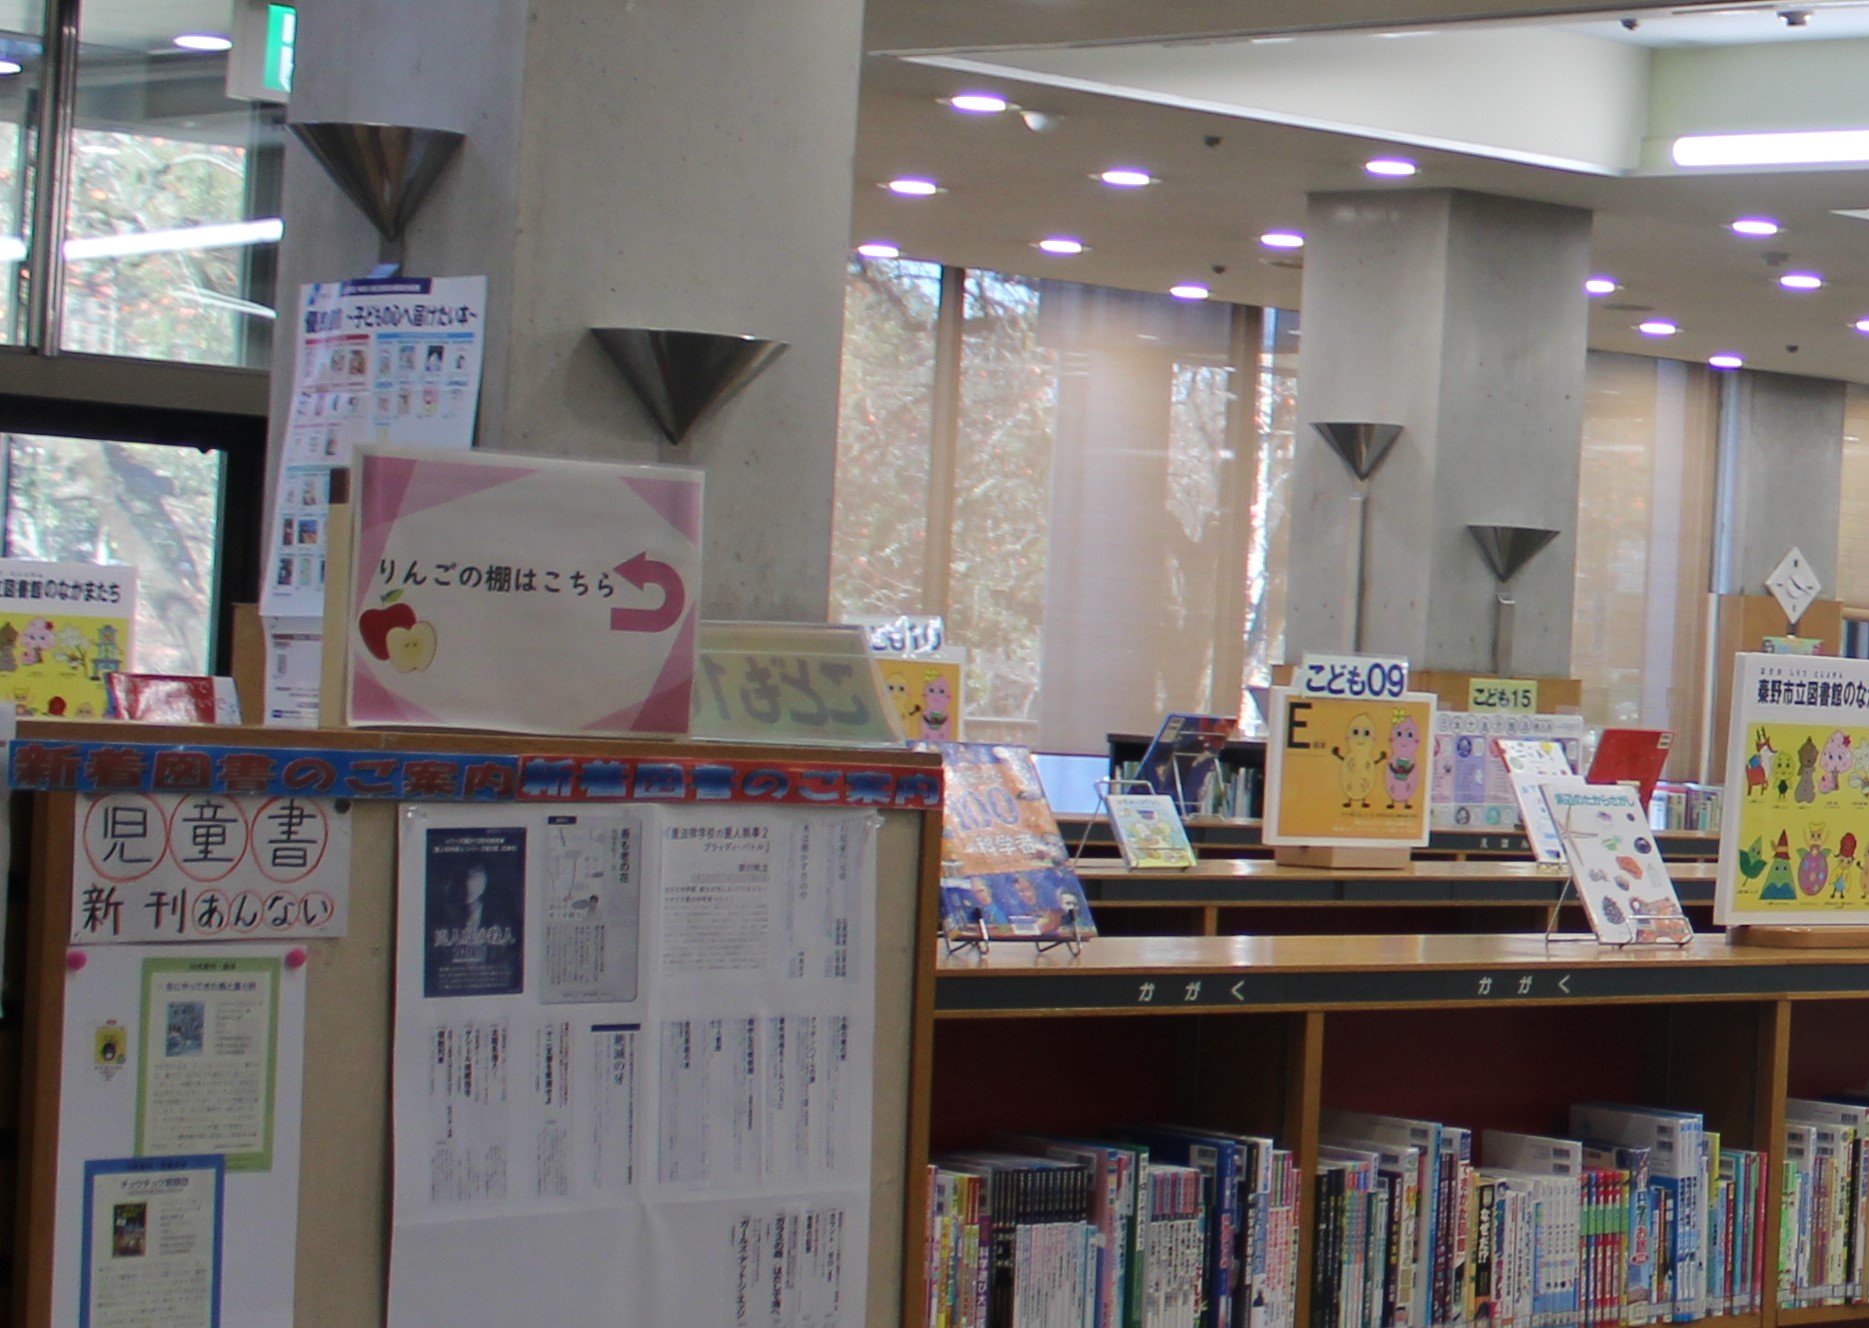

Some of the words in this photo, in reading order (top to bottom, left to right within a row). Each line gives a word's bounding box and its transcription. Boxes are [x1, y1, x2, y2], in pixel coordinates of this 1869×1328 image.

[0, 578, 122, 605] 図書館のなかまたち
[379, 558, 615, 598] りんごの棚はこちら
[1305, 662, 1405, 698] こども09
[1473, 687, 1532, 708] こども15
[1286, 702, 1313, 750] E
[14, 742, 513, 799] 新着図書のご案内
[520, 757, 940, 806] 新着図書のご案内
[103, 798, 318, 868] 児童書
[83, 883, 329, 936] 新刊あんない
[1138, 980, 1247, 1002] かがく
[1477, 974, 1571, 995] かがく
